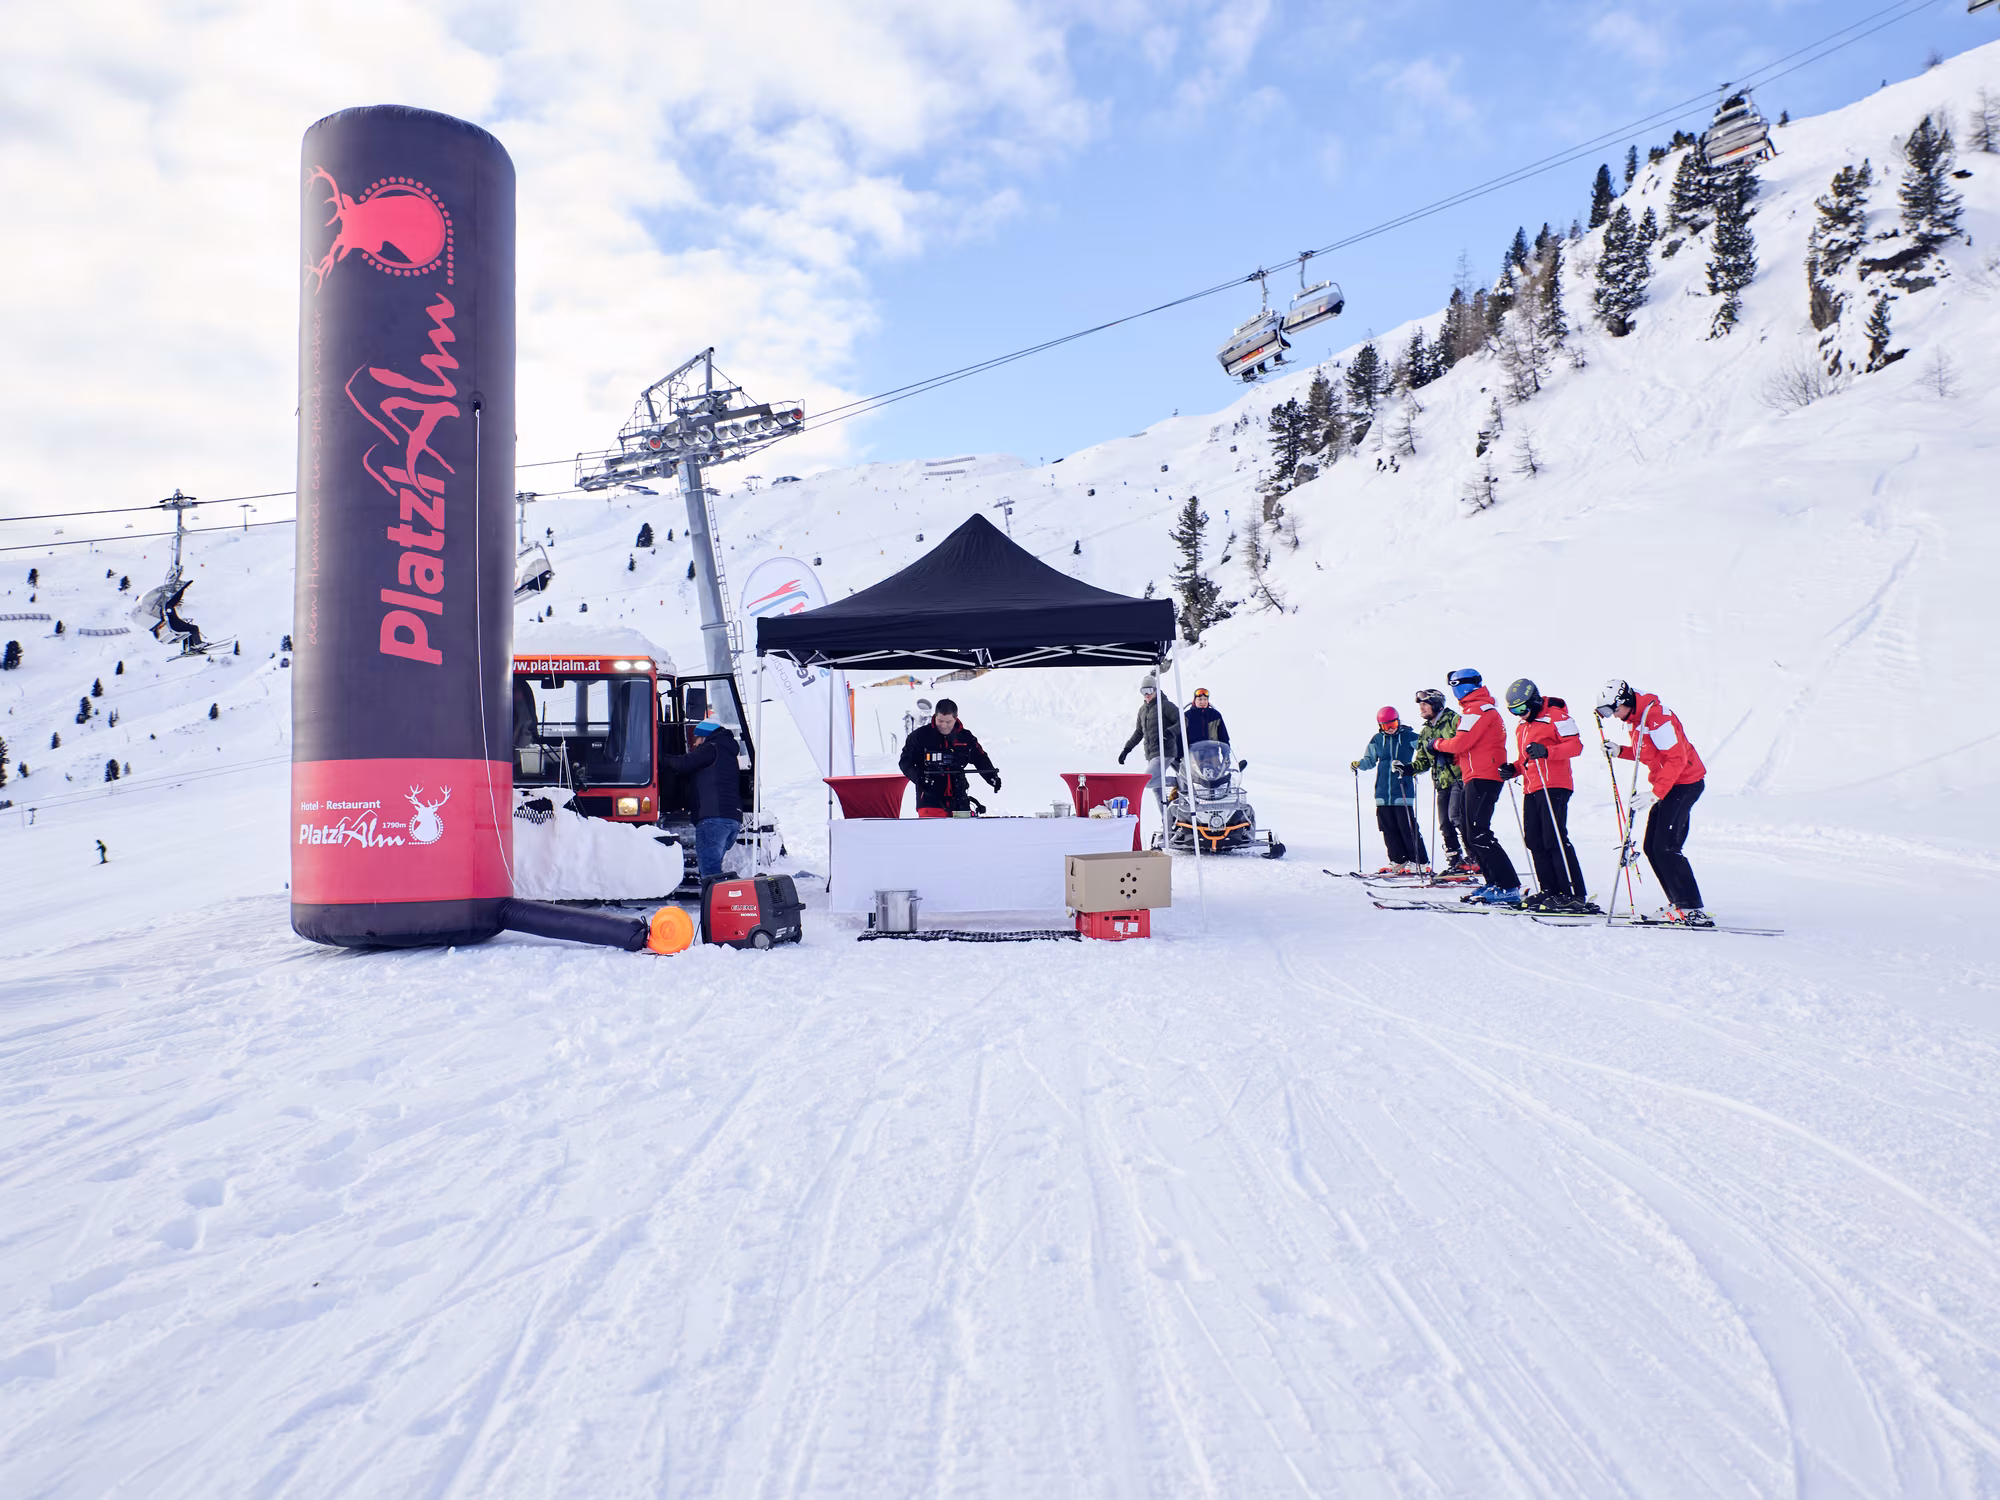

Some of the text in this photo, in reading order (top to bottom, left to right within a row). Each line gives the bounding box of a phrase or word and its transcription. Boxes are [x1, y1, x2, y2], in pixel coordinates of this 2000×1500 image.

[311, 451, 321, 490] ein
[308, 496, 321, 588] Himmel
[307, 594, 319, 645] dem
[513, 660, 600, 673] w.platzlalm.at
[300, 801, 319, 811] Hotel
[326, 800, 382, 810] Restaurant
